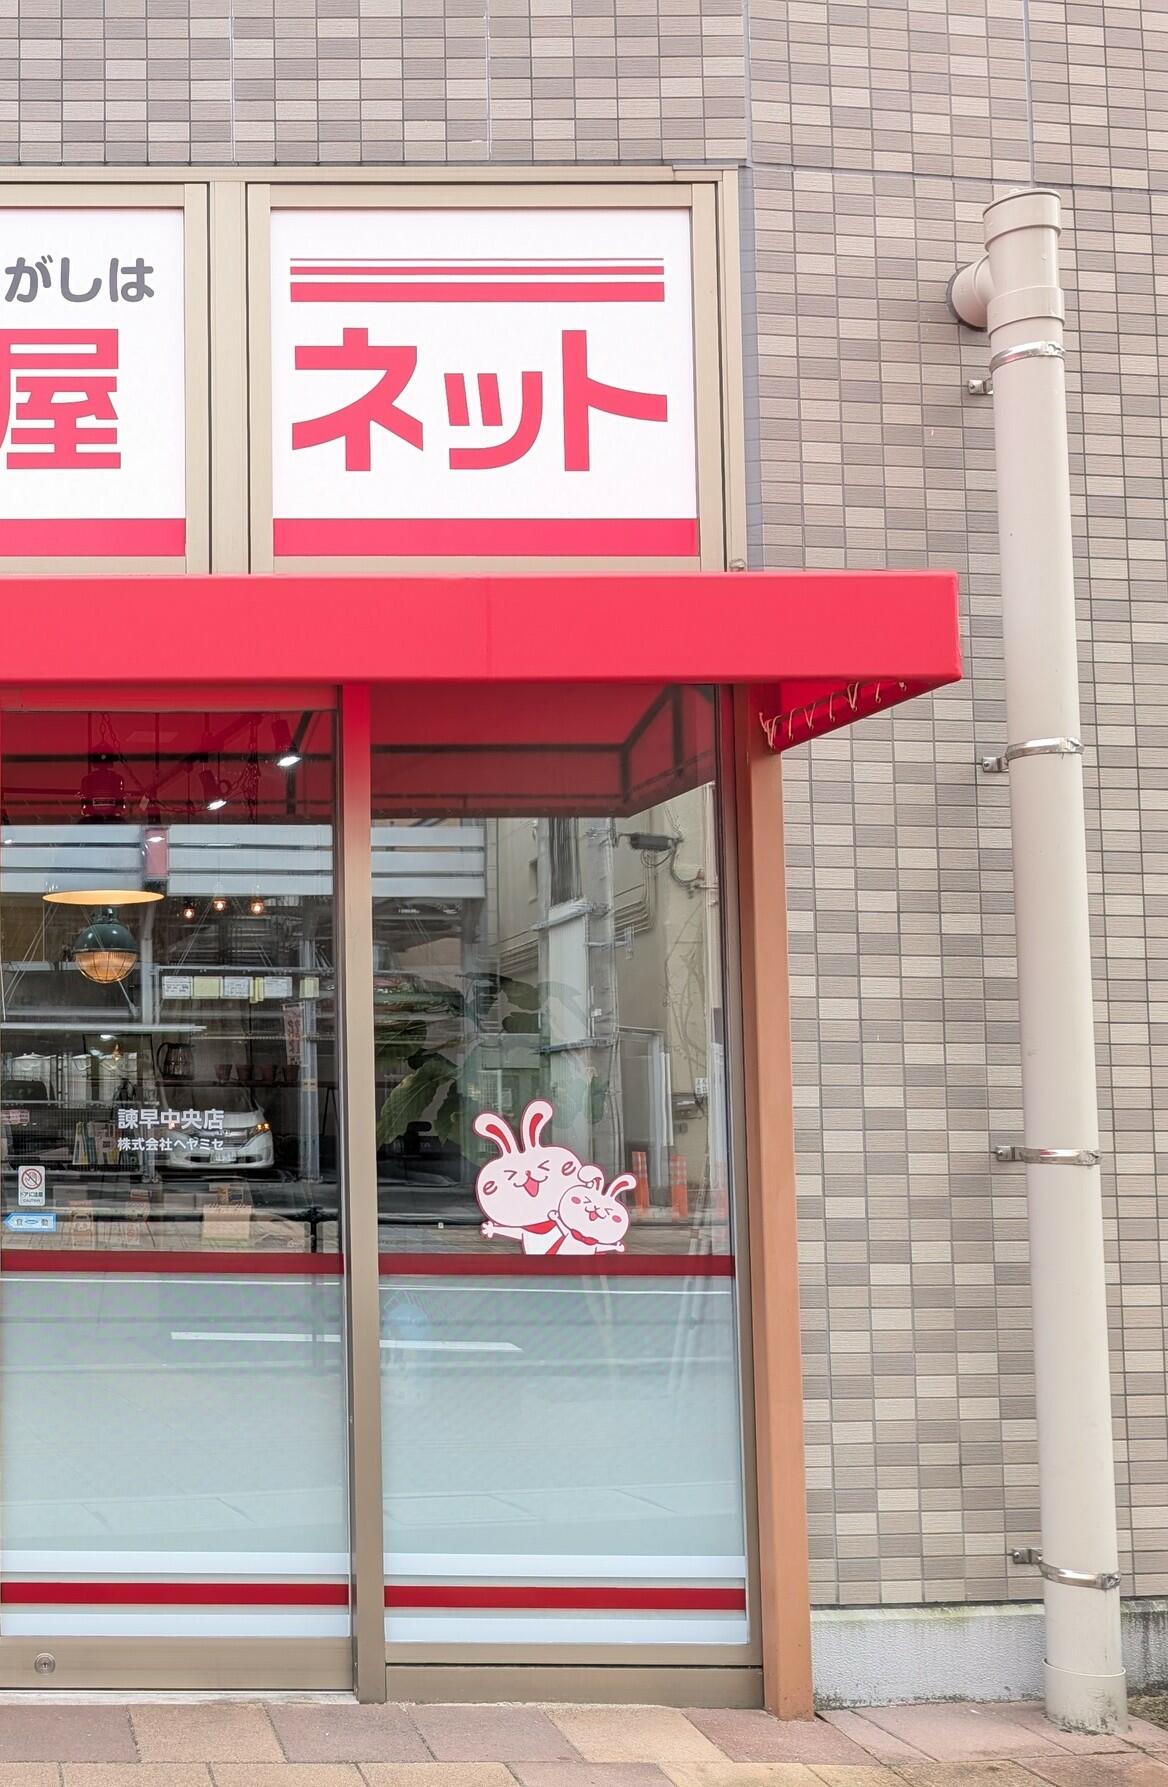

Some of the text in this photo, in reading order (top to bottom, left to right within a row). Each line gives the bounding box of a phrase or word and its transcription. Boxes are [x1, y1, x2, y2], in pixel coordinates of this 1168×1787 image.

[291, 327, 668, 472] ネット
[117, 1137, 224, 1151] 株式会社ヘヤミセ
